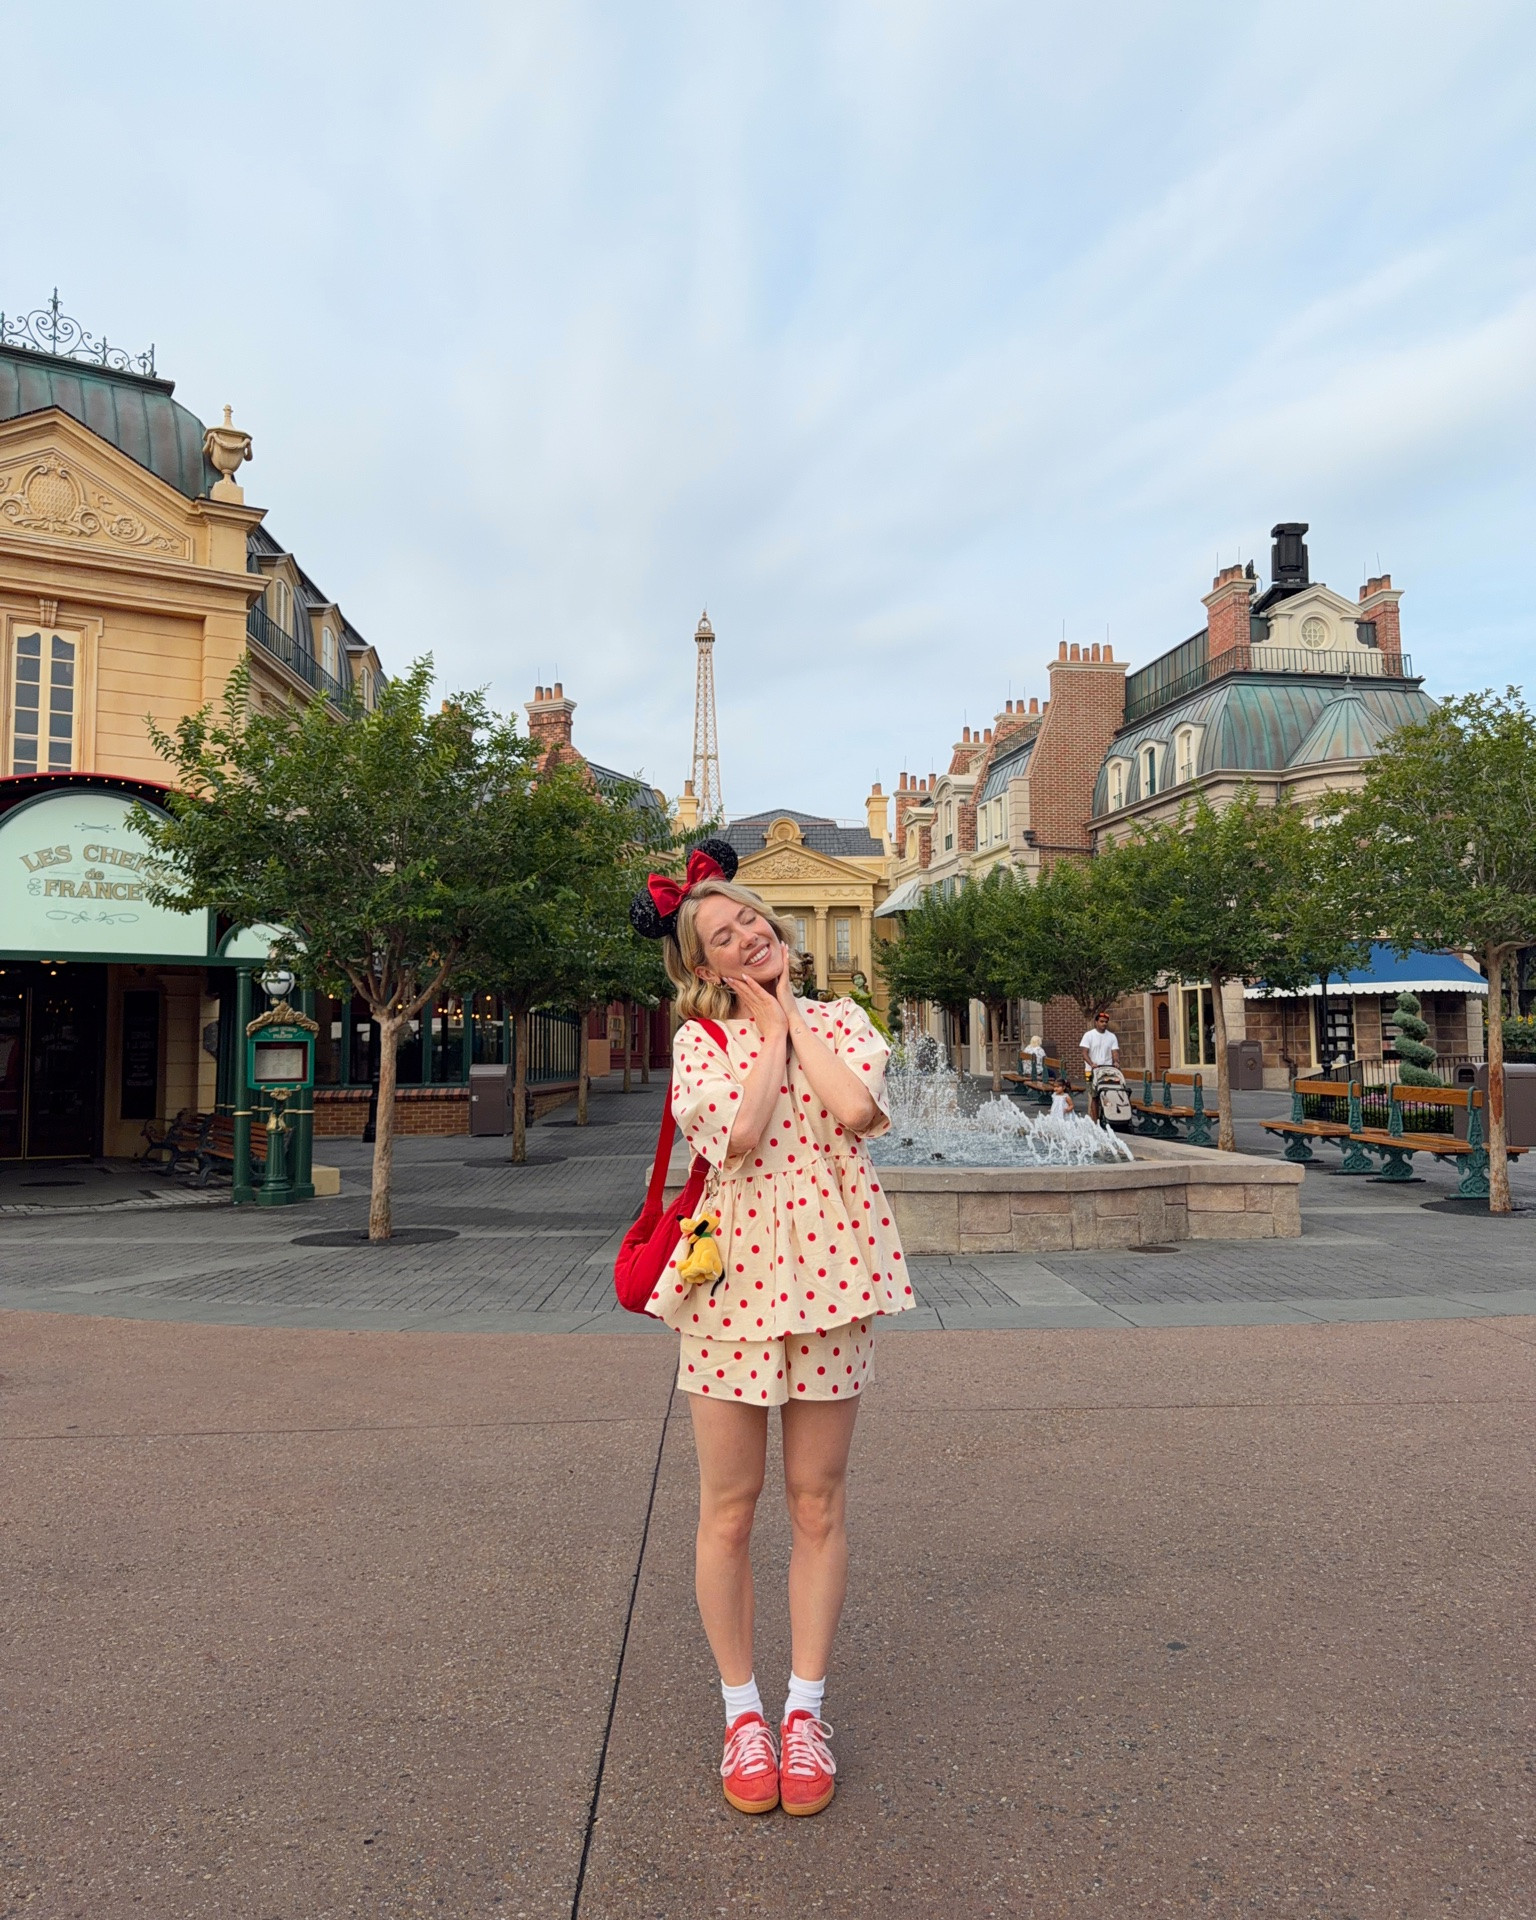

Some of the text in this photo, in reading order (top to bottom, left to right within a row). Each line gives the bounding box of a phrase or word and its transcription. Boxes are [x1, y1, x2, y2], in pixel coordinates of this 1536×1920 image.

[19, 845, 73, 873] LES
[84, 868, 105, 881] de
[43, 879, 143, 901] FRANCE
